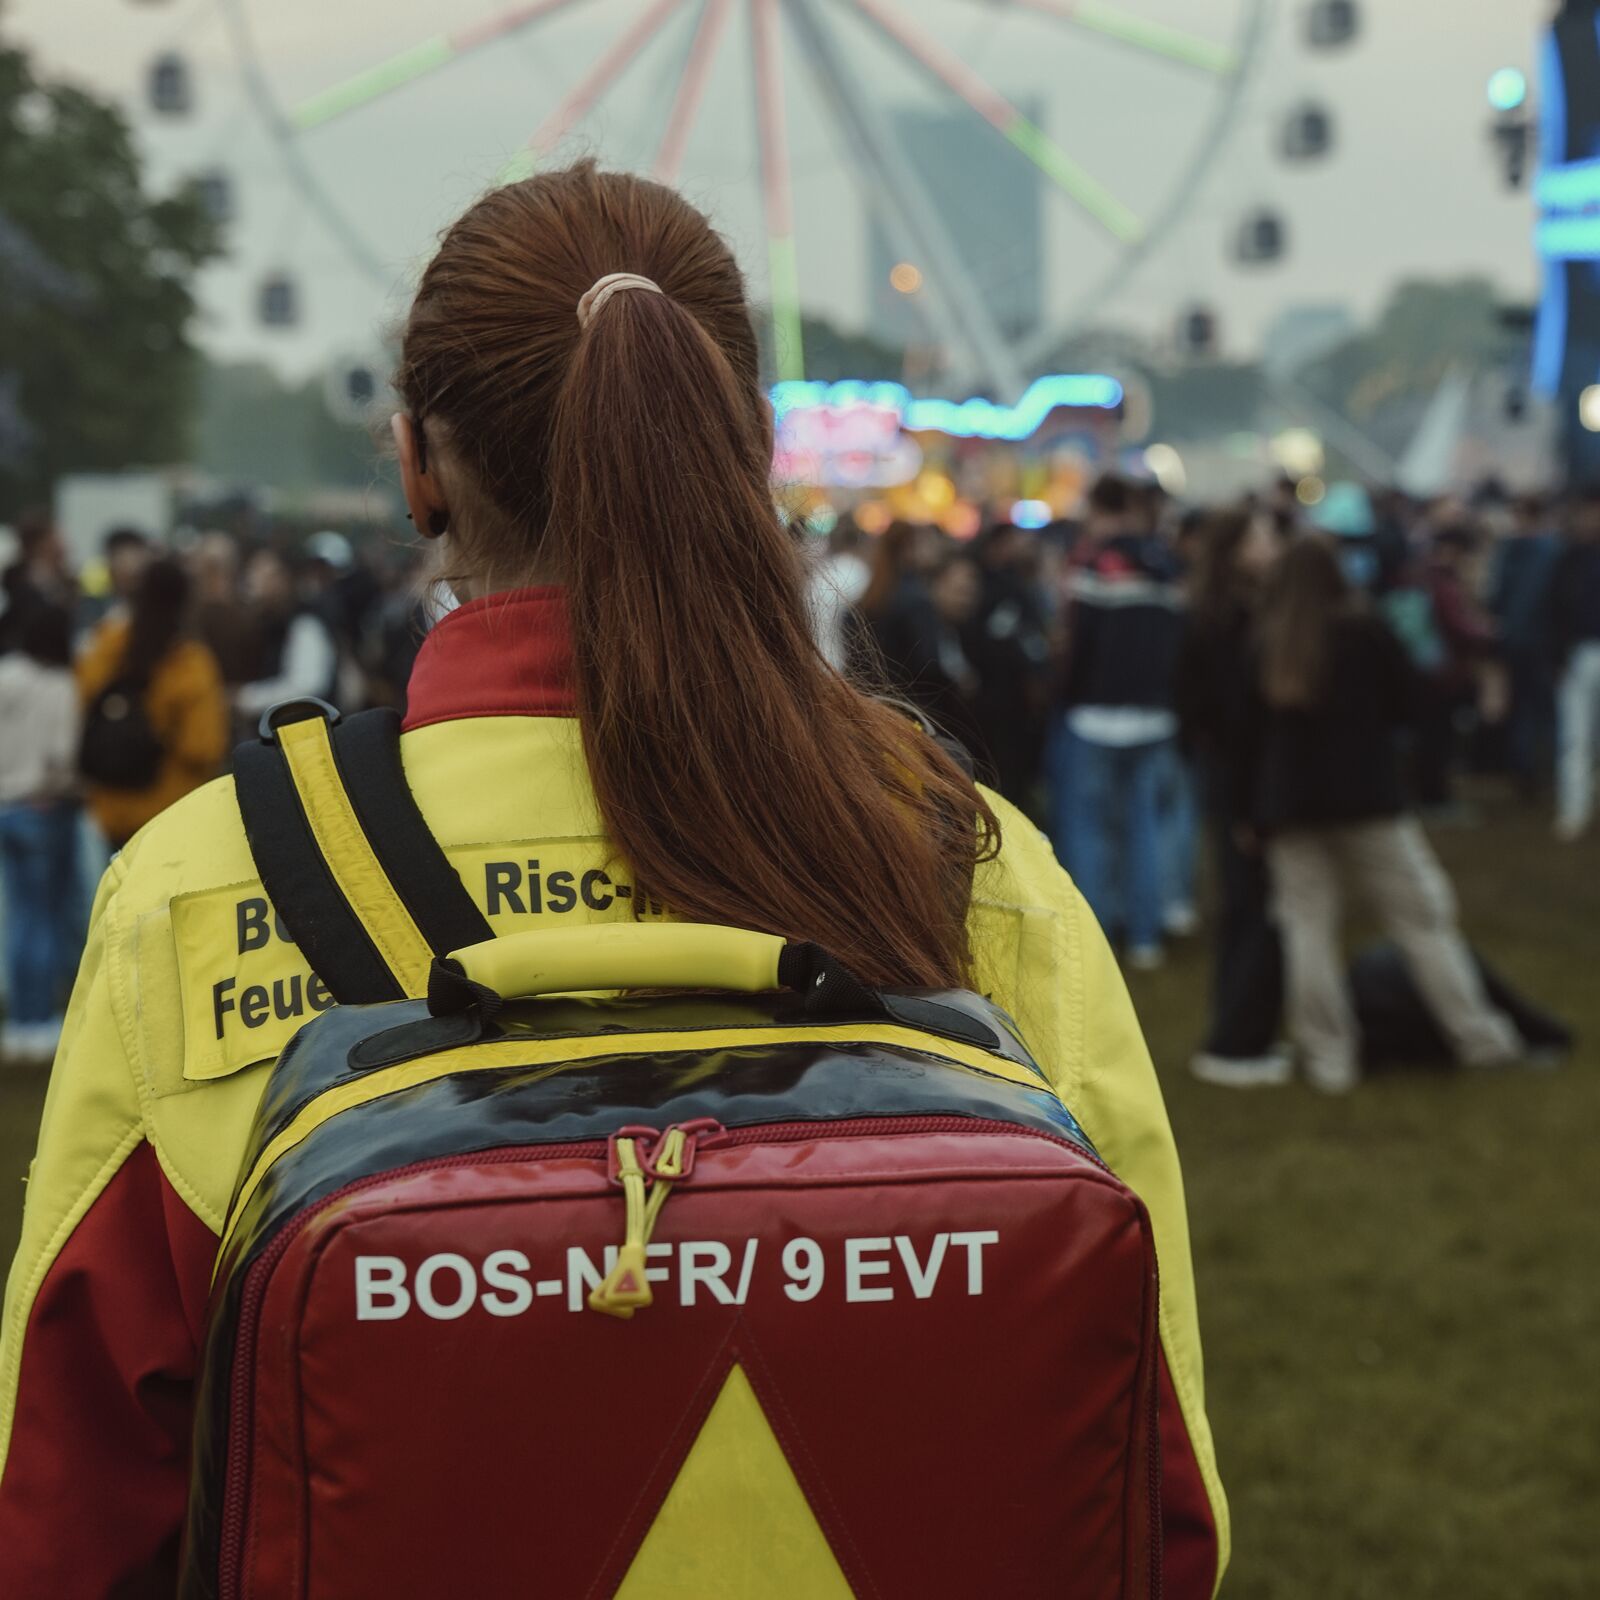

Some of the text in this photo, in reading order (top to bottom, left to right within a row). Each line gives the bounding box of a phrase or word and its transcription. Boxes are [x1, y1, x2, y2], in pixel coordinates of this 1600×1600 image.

[485, 859, 667, 916] Risc-
[782, 1237, 825, 1303] 9
[845, 1231, 999, 1303] EVT
